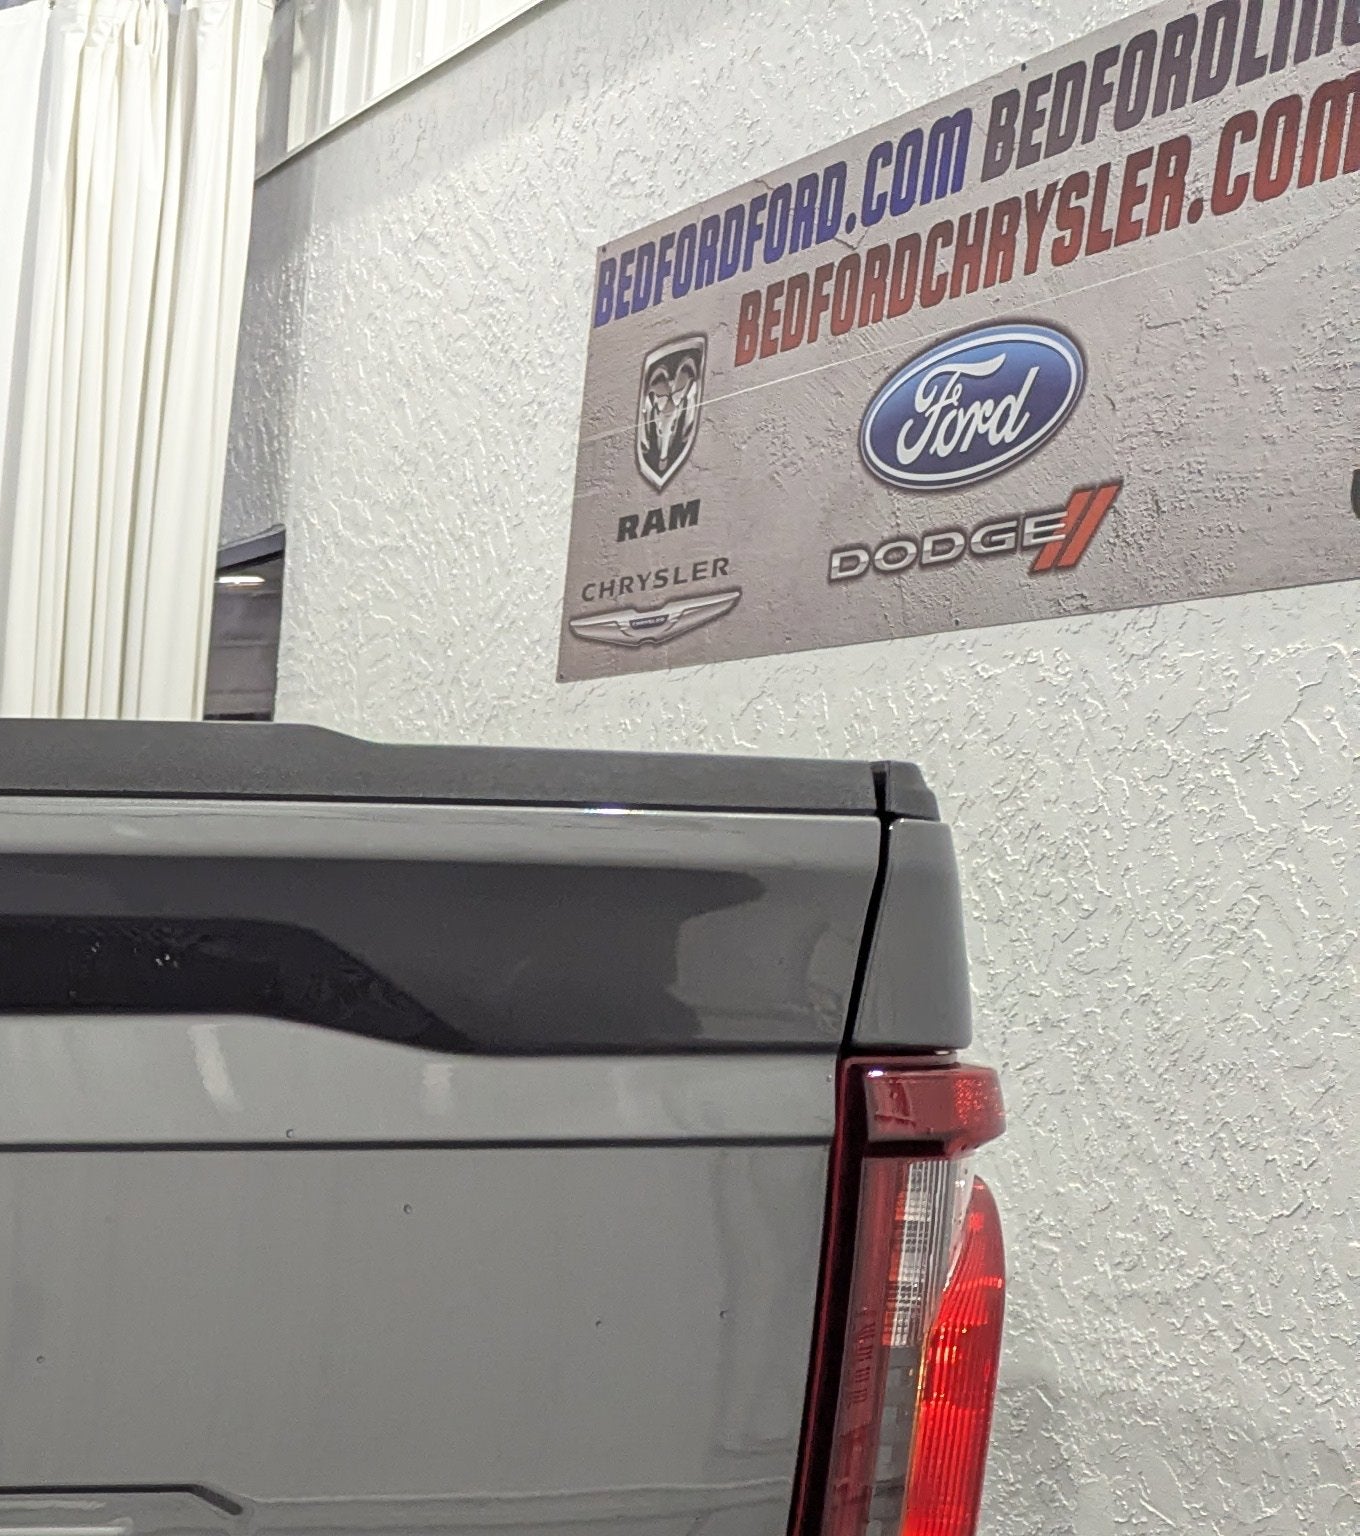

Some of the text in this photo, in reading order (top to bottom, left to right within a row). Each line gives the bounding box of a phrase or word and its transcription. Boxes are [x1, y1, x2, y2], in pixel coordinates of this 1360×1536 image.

[593, 0, 1360, 328] BEDFORDFORD.COM BEDFORDLIN
[734, 70, 1360, 367] BEDFORDCHRYSLER.COM
[896, 352, 1040, 465] Ford
[616, 498, 701, 542] RAM
[830, 511, 1069, 580] DODGE
[581, 557, 730, 602] CHRYSLER
